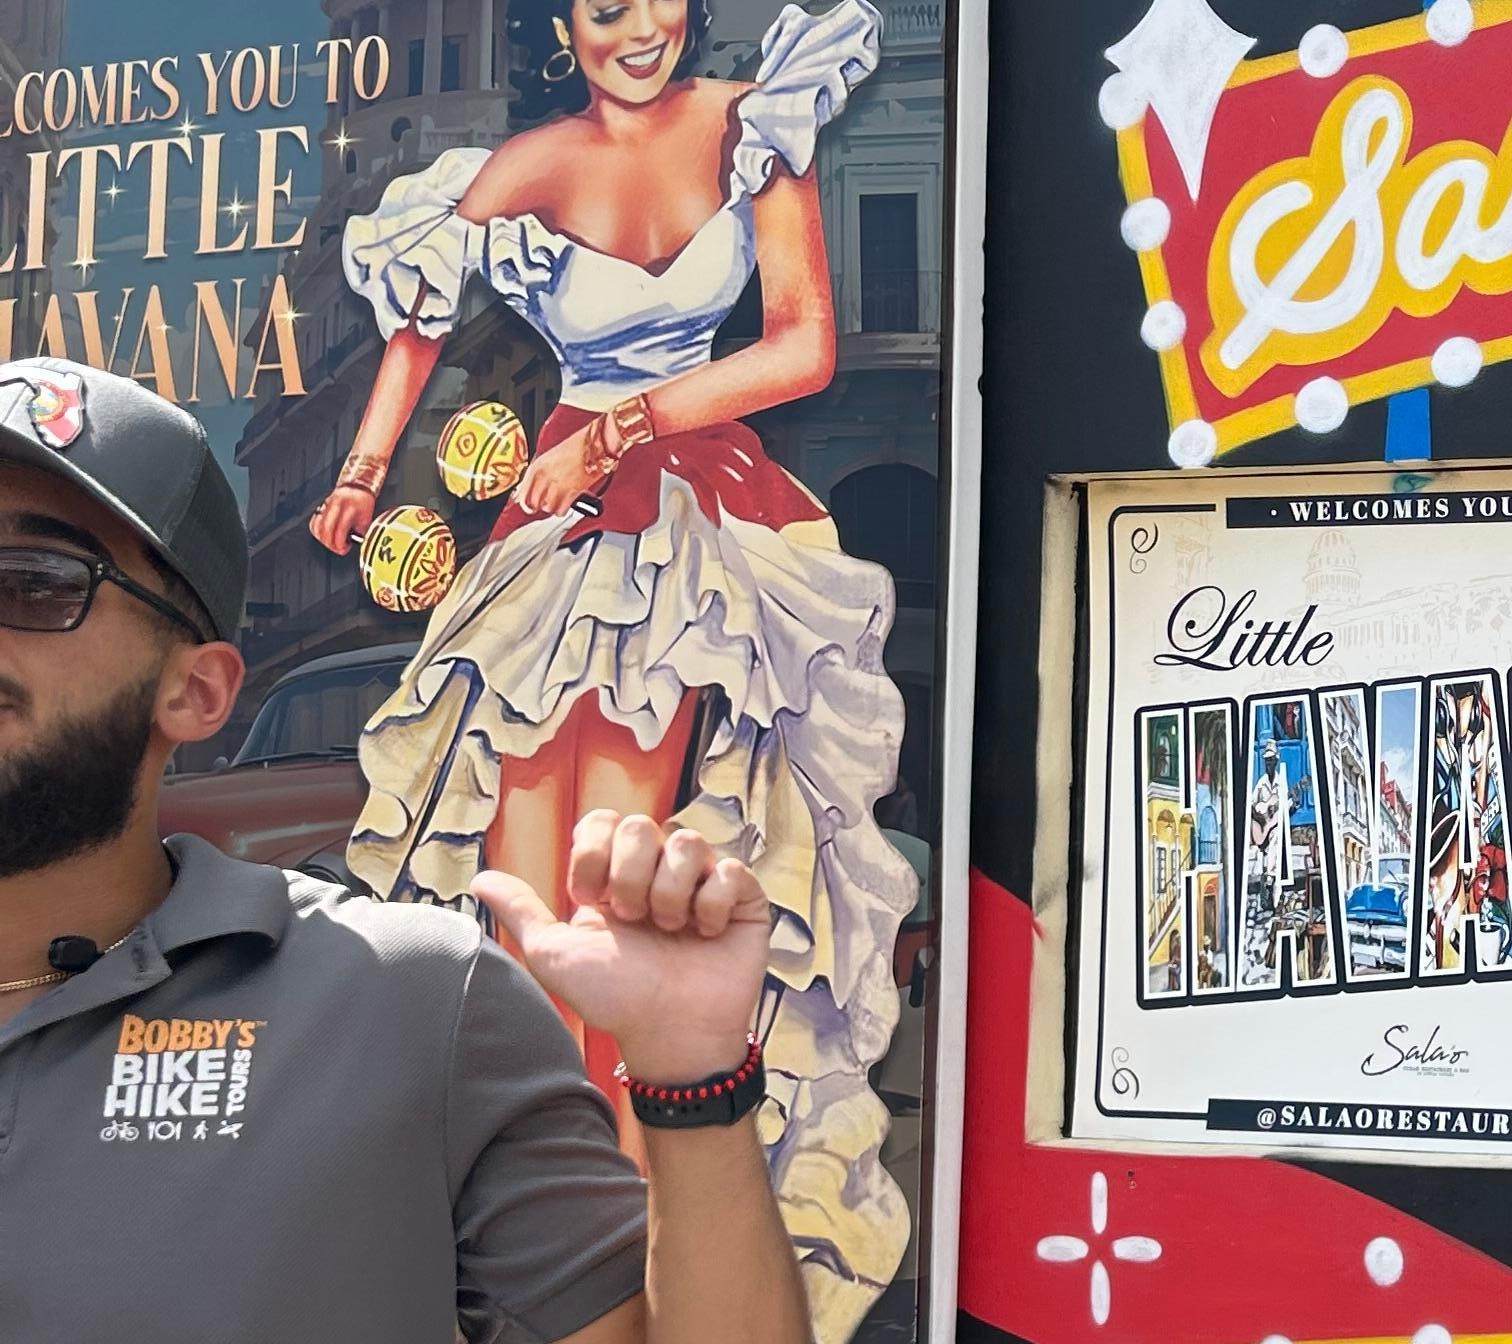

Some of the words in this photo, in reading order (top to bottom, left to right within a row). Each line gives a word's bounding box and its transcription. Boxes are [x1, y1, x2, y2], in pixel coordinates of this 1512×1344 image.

[197, 43, 300, 116] YOU
[315, 35, 390, 105] TO
[0, 125, 309, 274] ITTLE
[1289, 495, 1450, 521] WELCOMES
[1153, 585, 1335, 671] Little
[117, 1014, 256, 1054] BOBBY'S
[112, 1048, 227, 1085] BIKE
[225, 1049, 252, 1117] TOURS
[103, 1081, 221, 1117] HIKE
